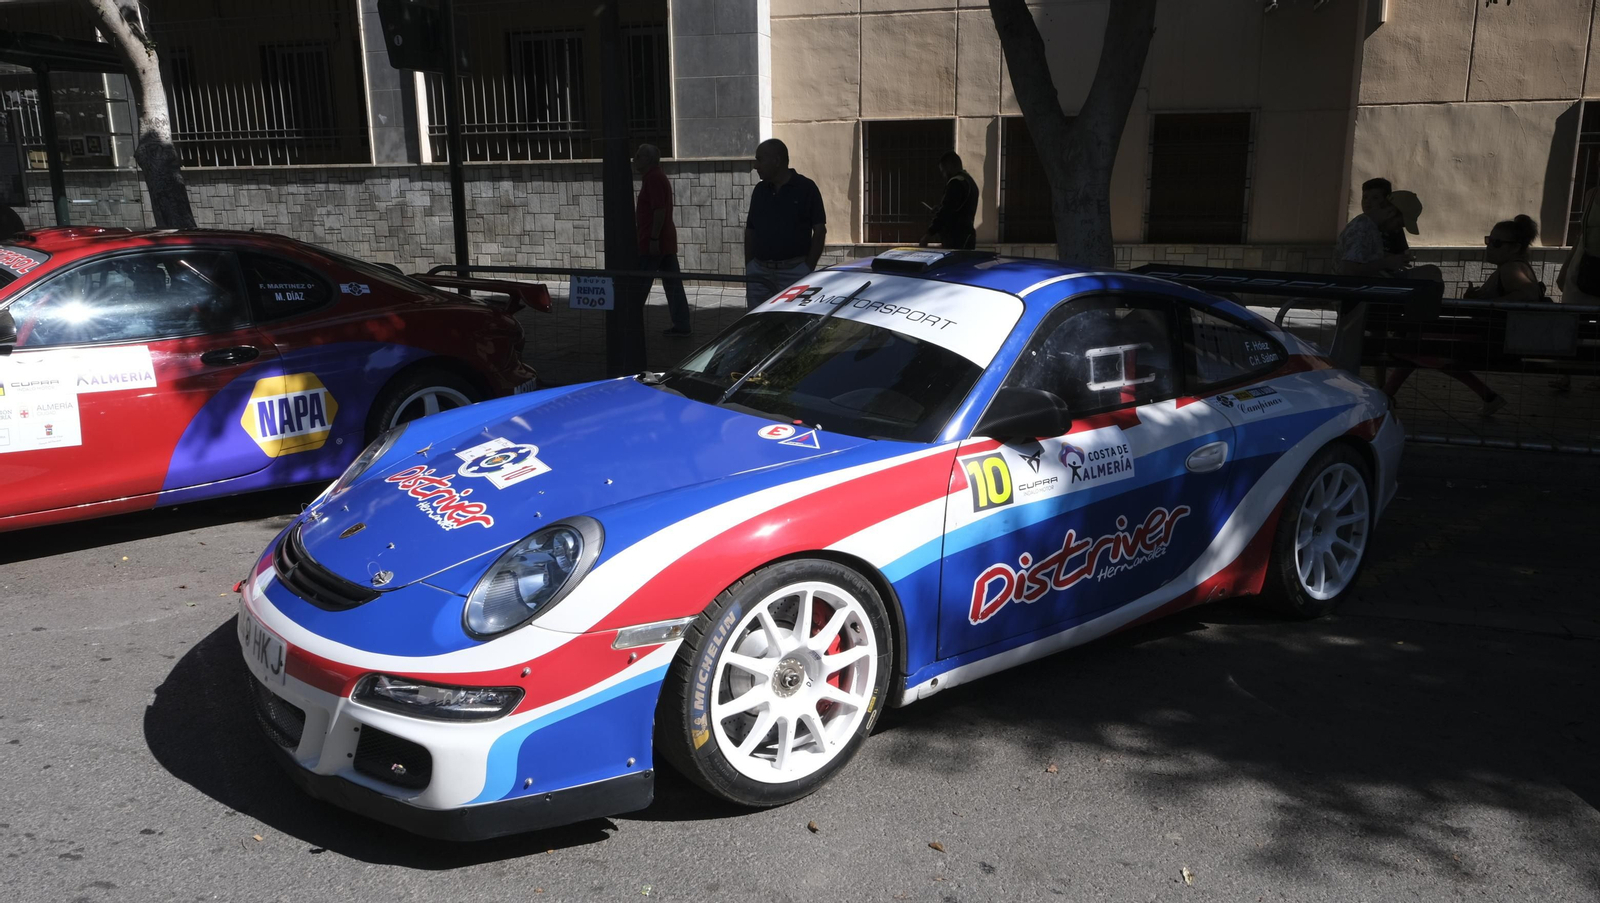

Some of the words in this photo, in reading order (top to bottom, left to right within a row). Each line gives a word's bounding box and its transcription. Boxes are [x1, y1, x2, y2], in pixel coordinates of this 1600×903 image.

[577, 286, 606, 295] RENTA
[1144, 271, 1415, 295] PORSCHE
[275, 292, 286, 301] M.
[286, 291, 305, 301] DÍAZ
[576, 296, 606, 307] TODO
[813, 294, 958, 330] MOTORSPORT
[1244, 341, 1254, 351] F.
[10, 379, 60, 388] CUPRA
[90, 371, 153, 385] ALMERÍA
[36, 401, 74, 411] ALMERÍA
[257, 392, 327, 438] NAPA
[766, 425, 788, 436] E
[1088, 448, 1117, 462] COSTA
[1117, 443, 1129, 454] DE
[1082, 455, 1133, 482] ALMERÍA
[965, 456, 1012, 508] 10
[1018, 476, 1059, 491] CUPRA
[385, 465, 495, 529] Distriver
[968, 505, 1191, 626] Distriver
[1096, 543, 1167, 582] Hernandez
[694, 611, 736, 711] MICHELIN
